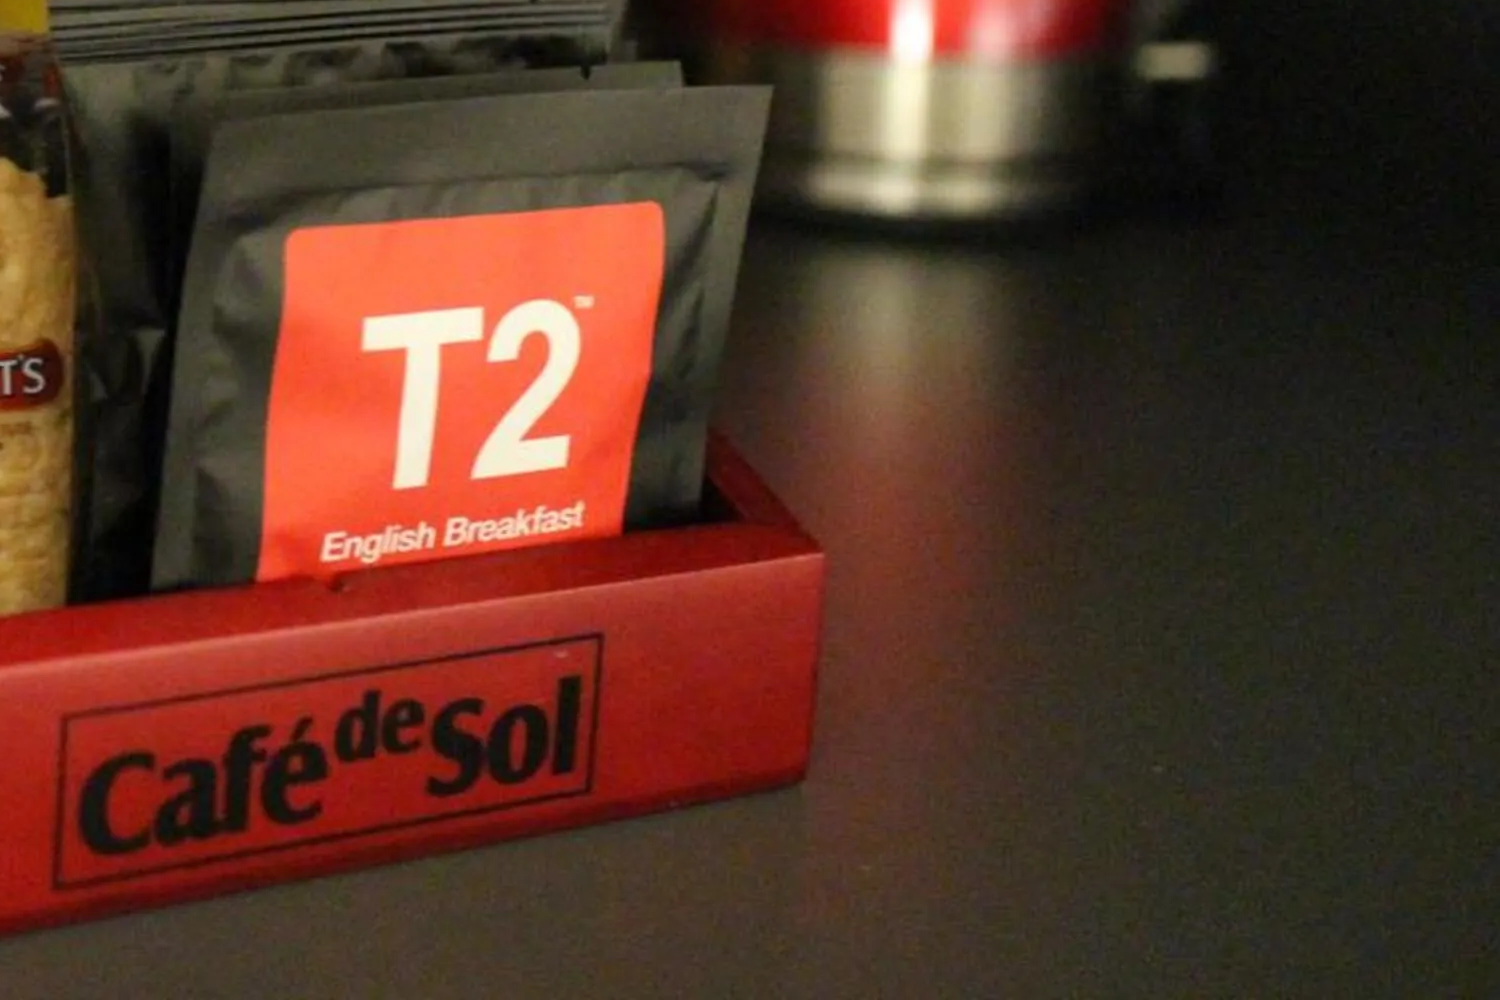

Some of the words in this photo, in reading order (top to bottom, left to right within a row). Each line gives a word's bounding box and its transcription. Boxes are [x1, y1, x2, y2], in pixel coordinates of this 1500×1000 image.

[319, 520, 436, 564] English
[442, 500, 586, 548] Breakfast
[77, 716, 329, 857] Café
[333, 689, 426, 762] de
[425, 674, 583, 797] Sol
